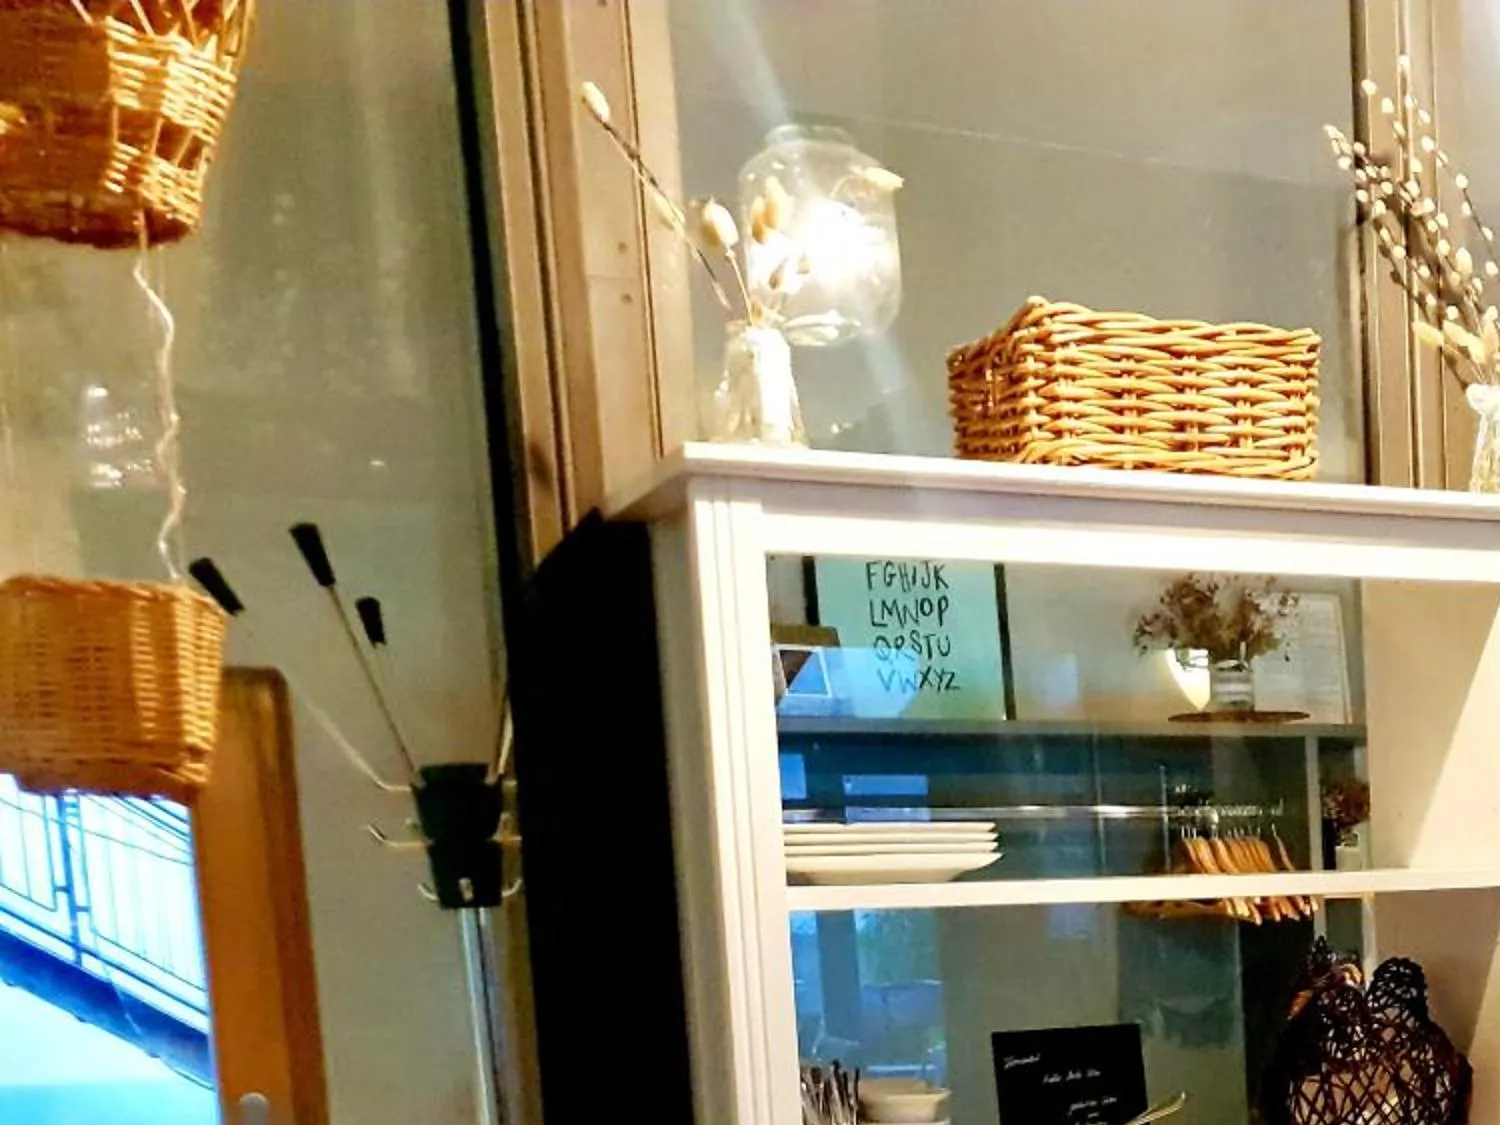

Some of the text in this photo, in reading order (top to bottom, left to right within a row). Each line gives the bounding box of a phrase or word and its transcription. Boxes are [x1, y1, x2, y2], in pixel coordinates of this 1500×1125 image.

[870, 595, 949, 629] LMNOP
[874, 629, 951, 664] QRSTU
[877, 666, 961, 694] VWXYZ
